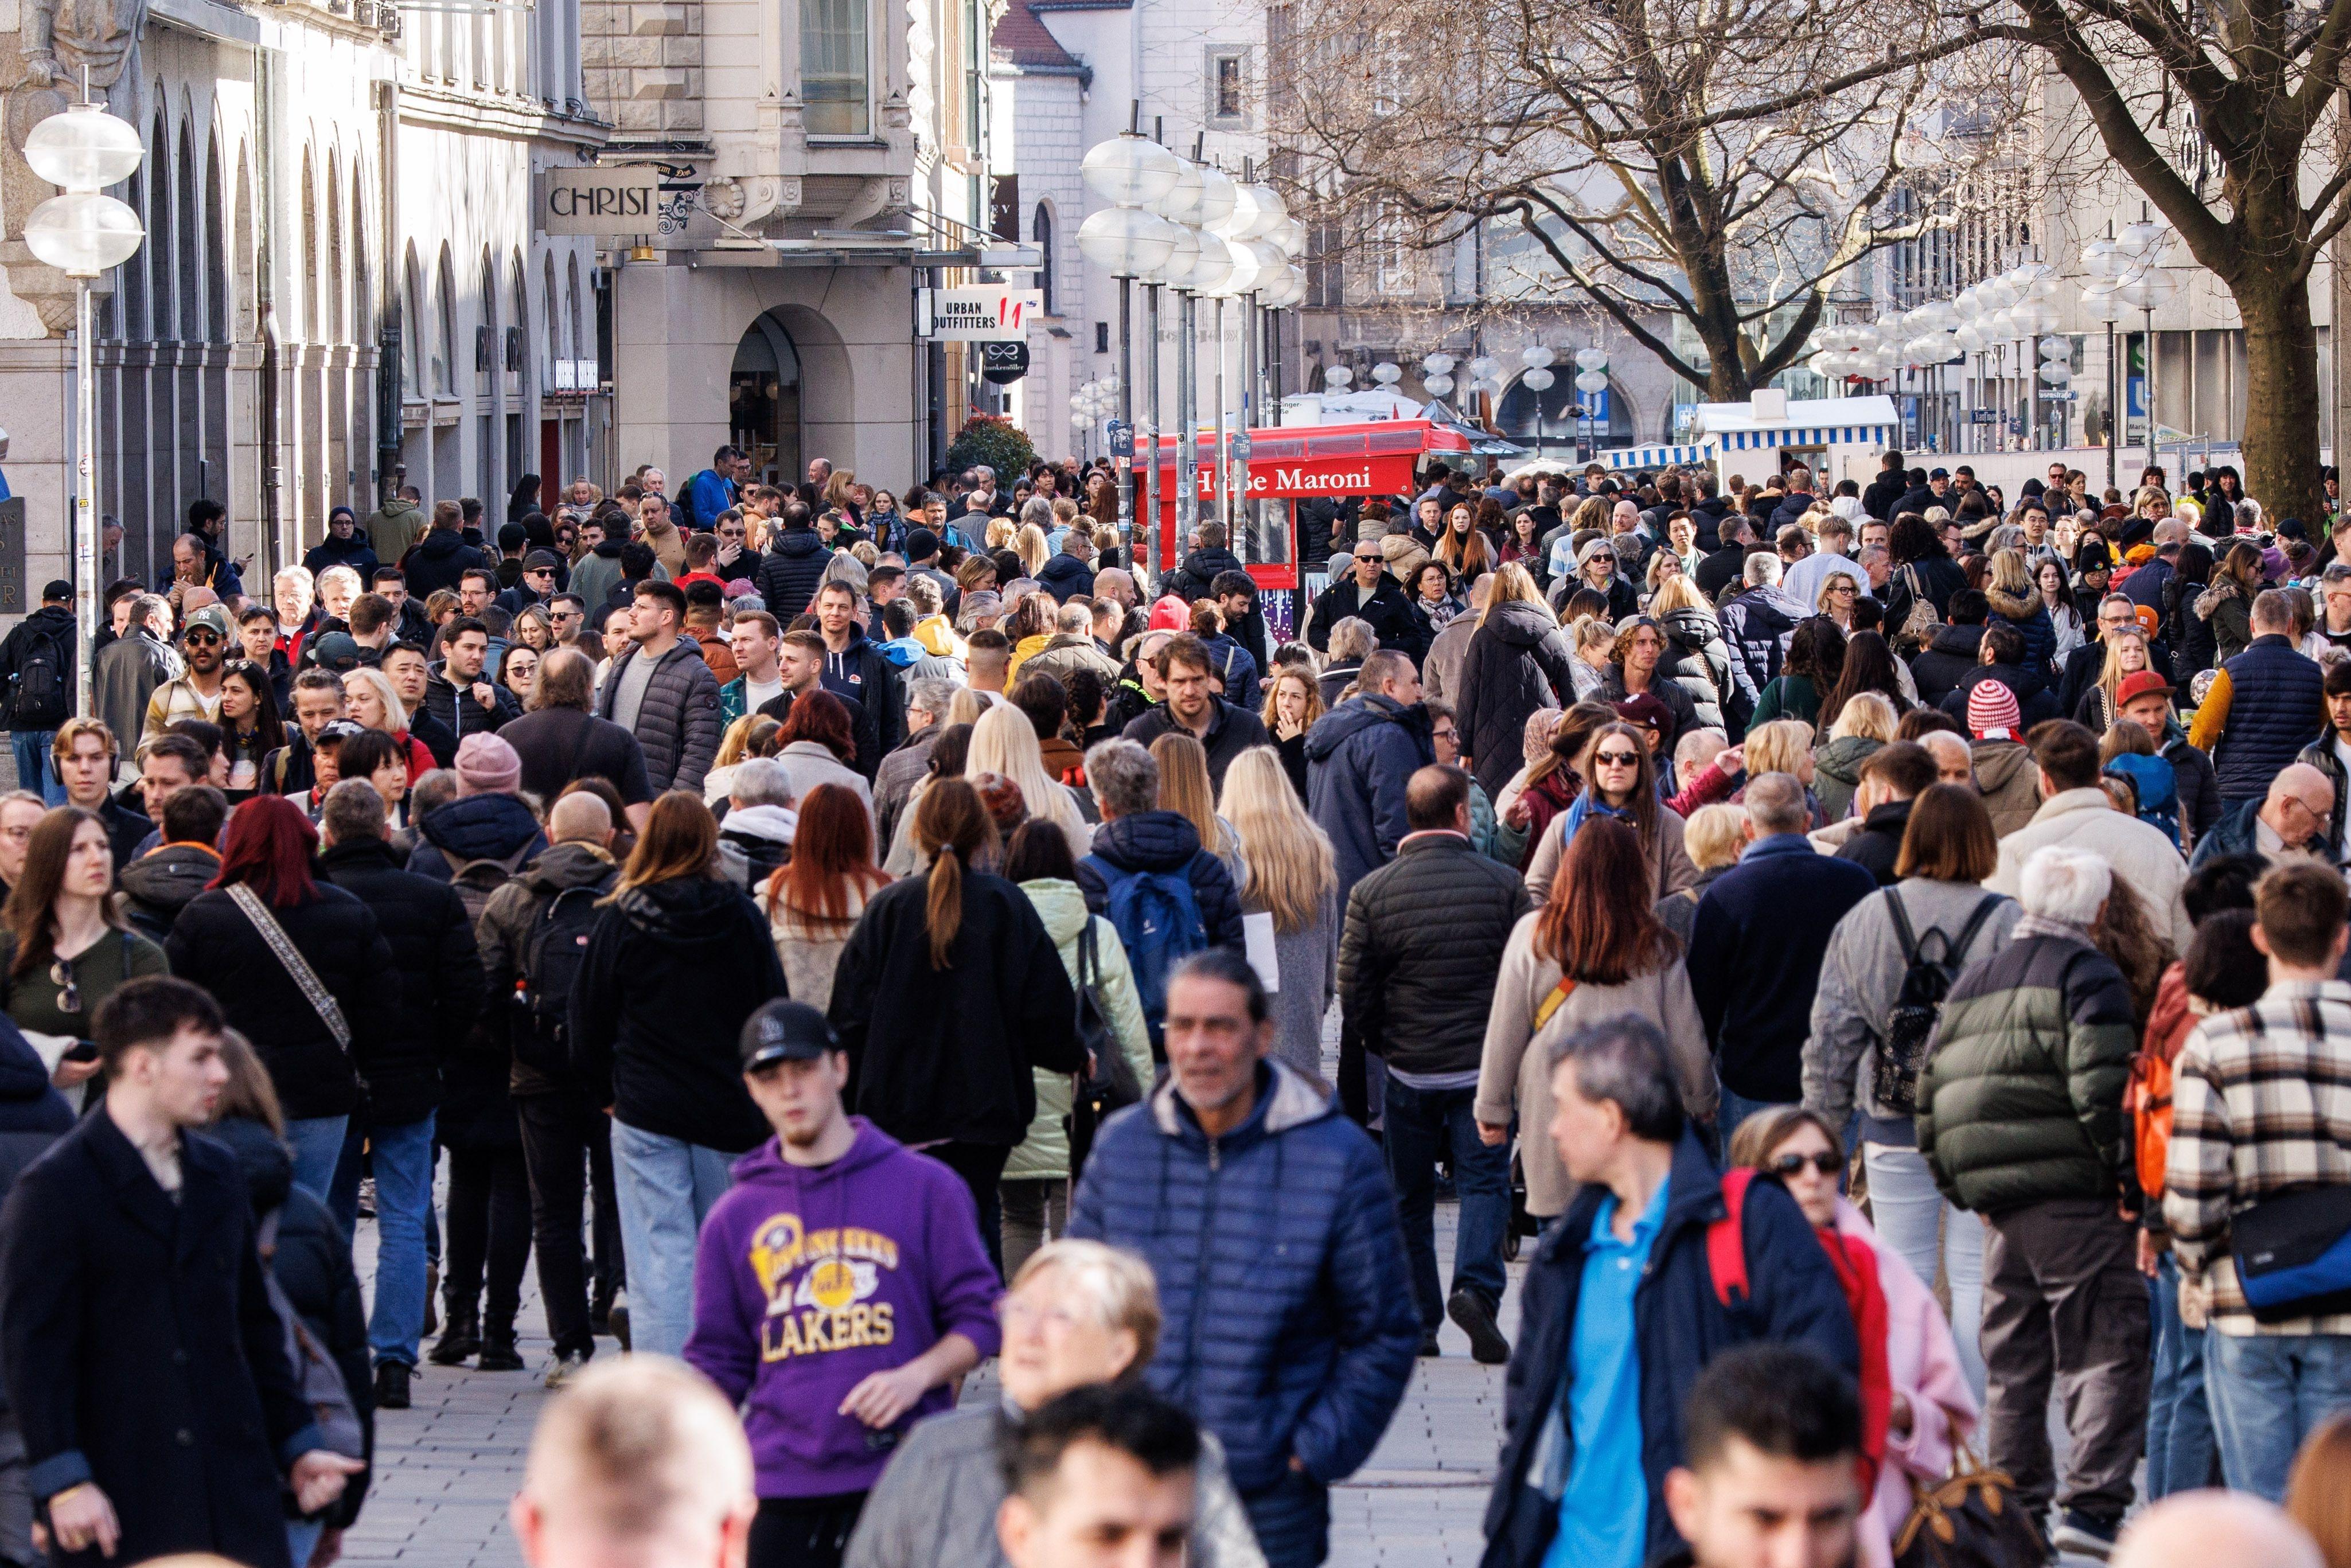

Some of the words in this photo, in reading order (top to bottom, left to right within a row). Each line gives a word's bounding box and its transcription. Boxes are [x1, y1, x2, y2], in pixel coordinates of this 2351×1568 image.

[675, 169, 691, 177] Dom
[549, 187, 653, 216] CHRIST
[946, 302, 981, 314] URBAN
[934, 317, 995, 329] OUTFITTERS
[1197, 470, 1266, 492] Hße
[1276, 466, 1371, 490] Maroni
[762, 1302, 894, 1363] LAKERS
